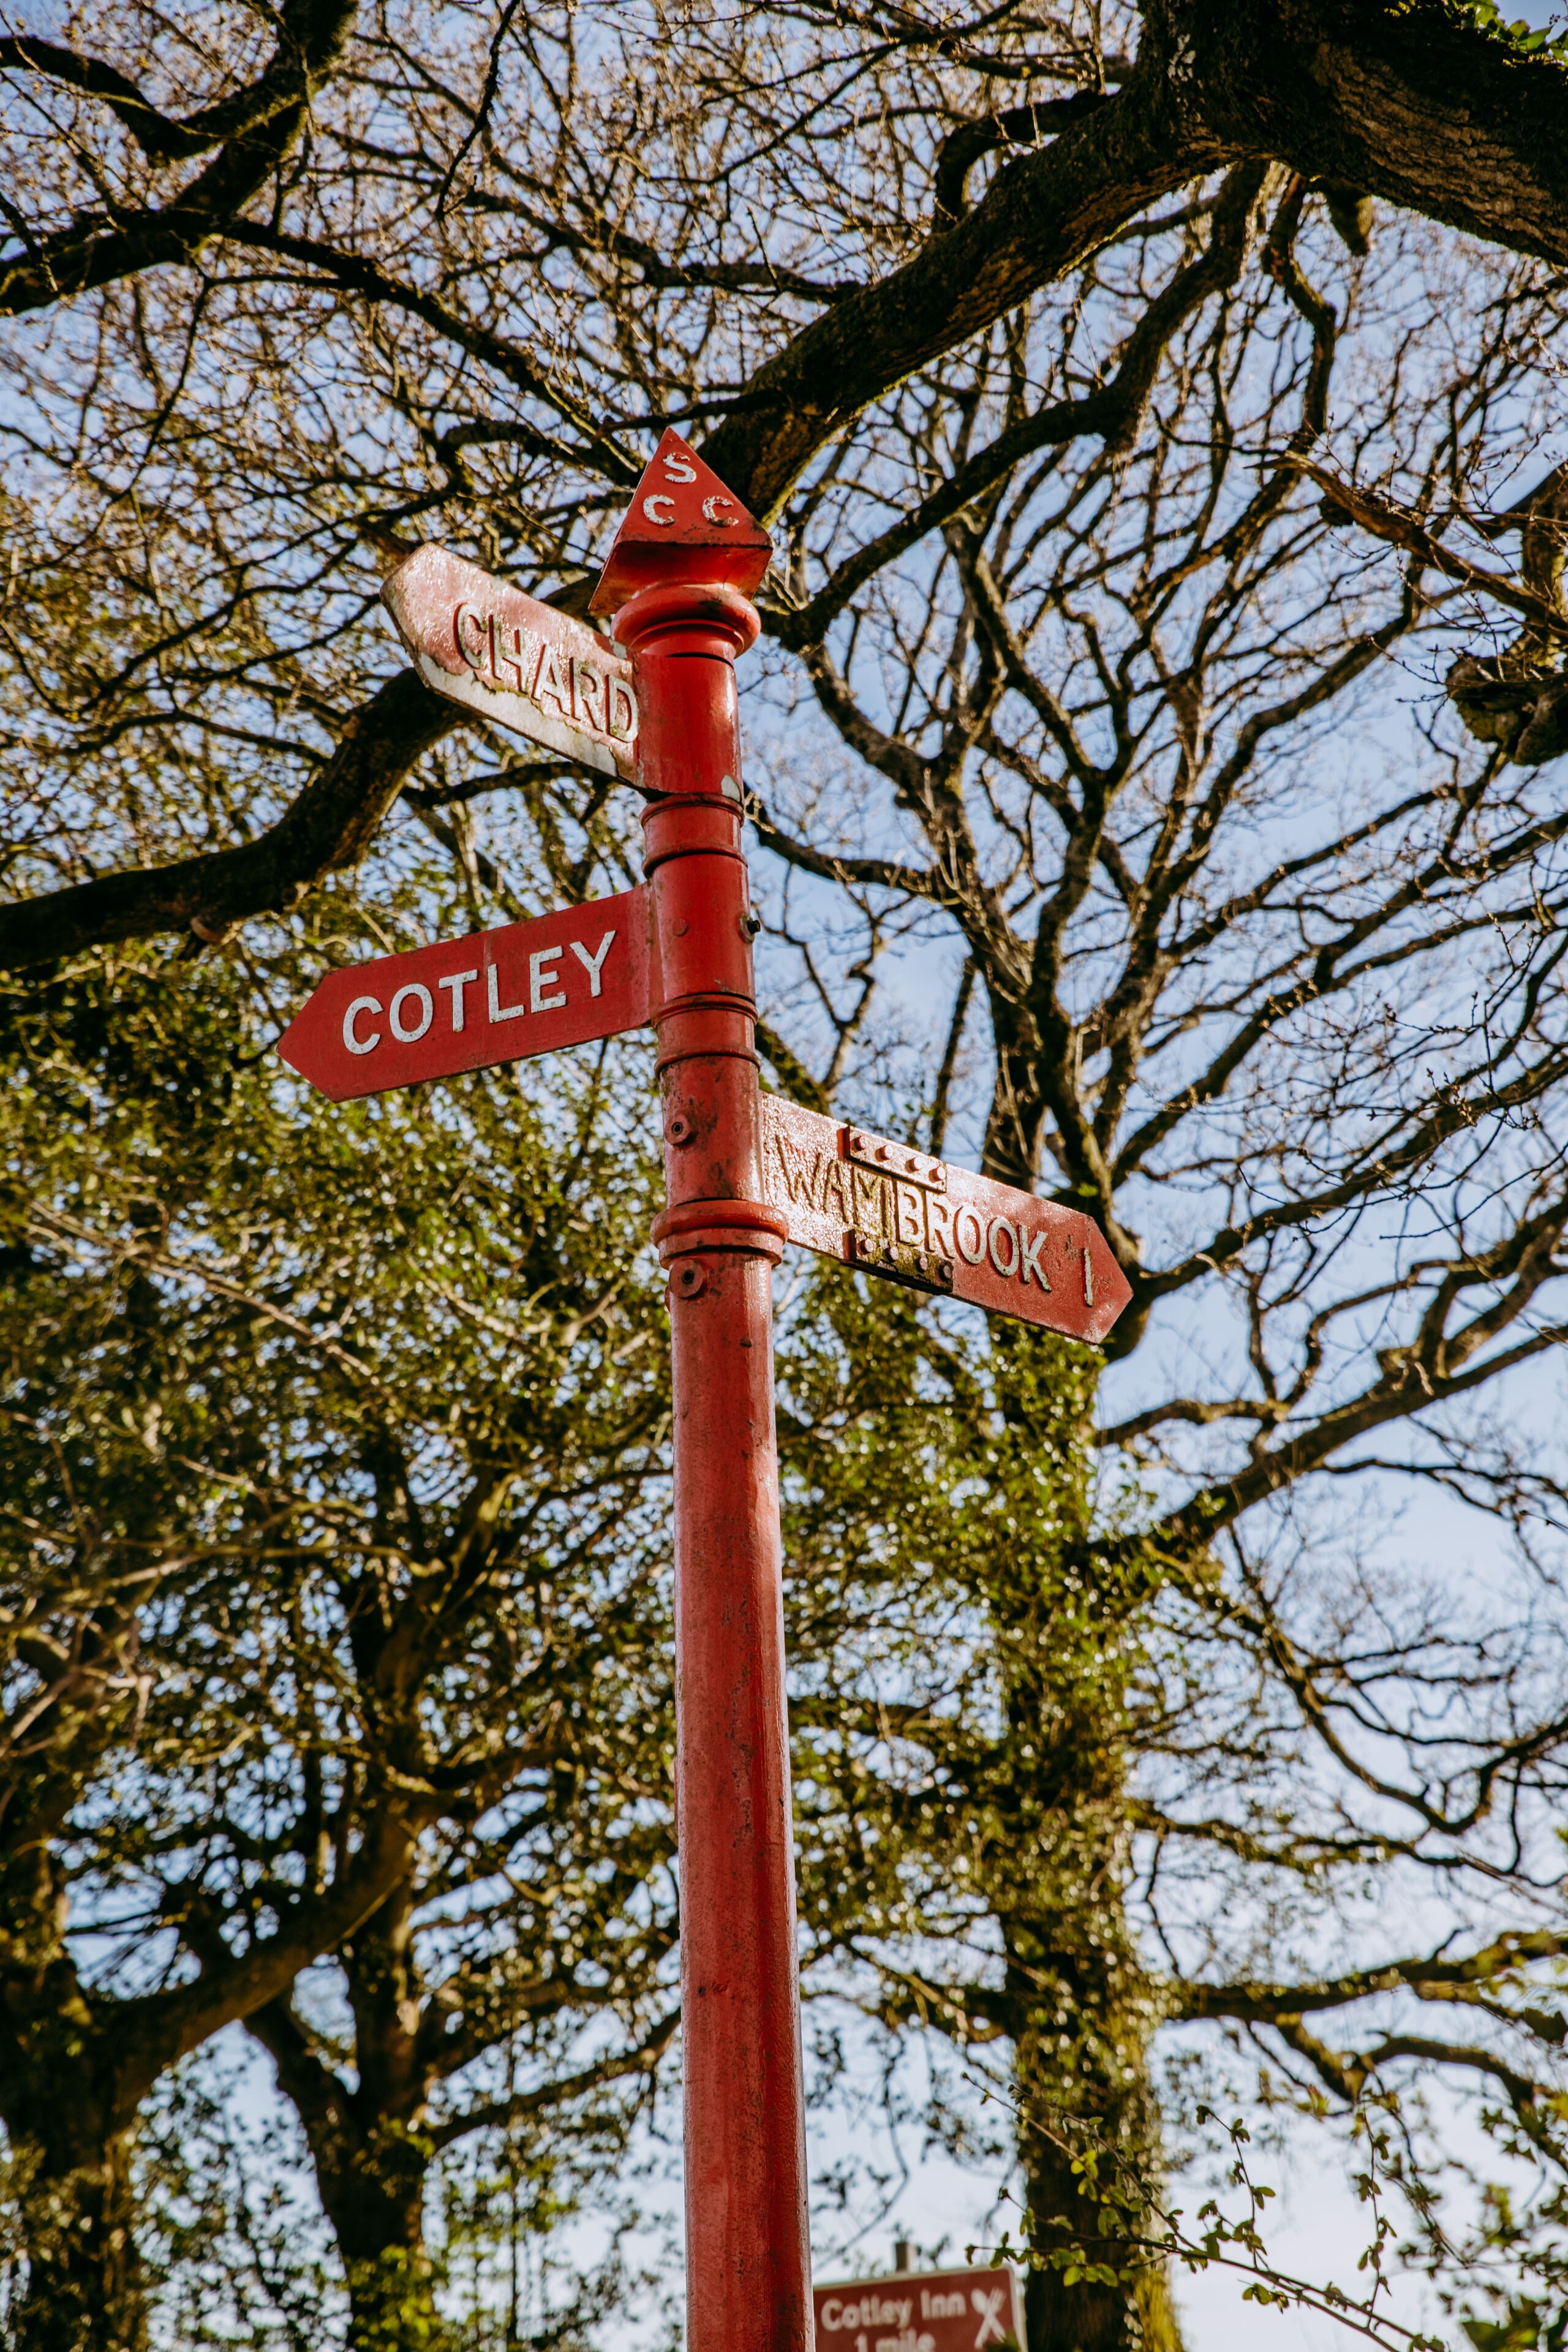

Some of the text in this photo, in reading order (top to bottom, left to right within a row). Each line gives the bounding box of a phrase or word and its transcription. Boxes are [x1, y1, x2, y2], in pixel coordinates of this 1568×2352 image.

[663, 451, 697, 483] S
[453, 601, 639, 743] CHARD
[342, 930, 616, 1055] COTLEY
[775, 1133, 1052, 1292] WAMBROOK
[821, 2288, 967, 2332] Cotley Inn
[875, 2327, 935, 2352] mile
